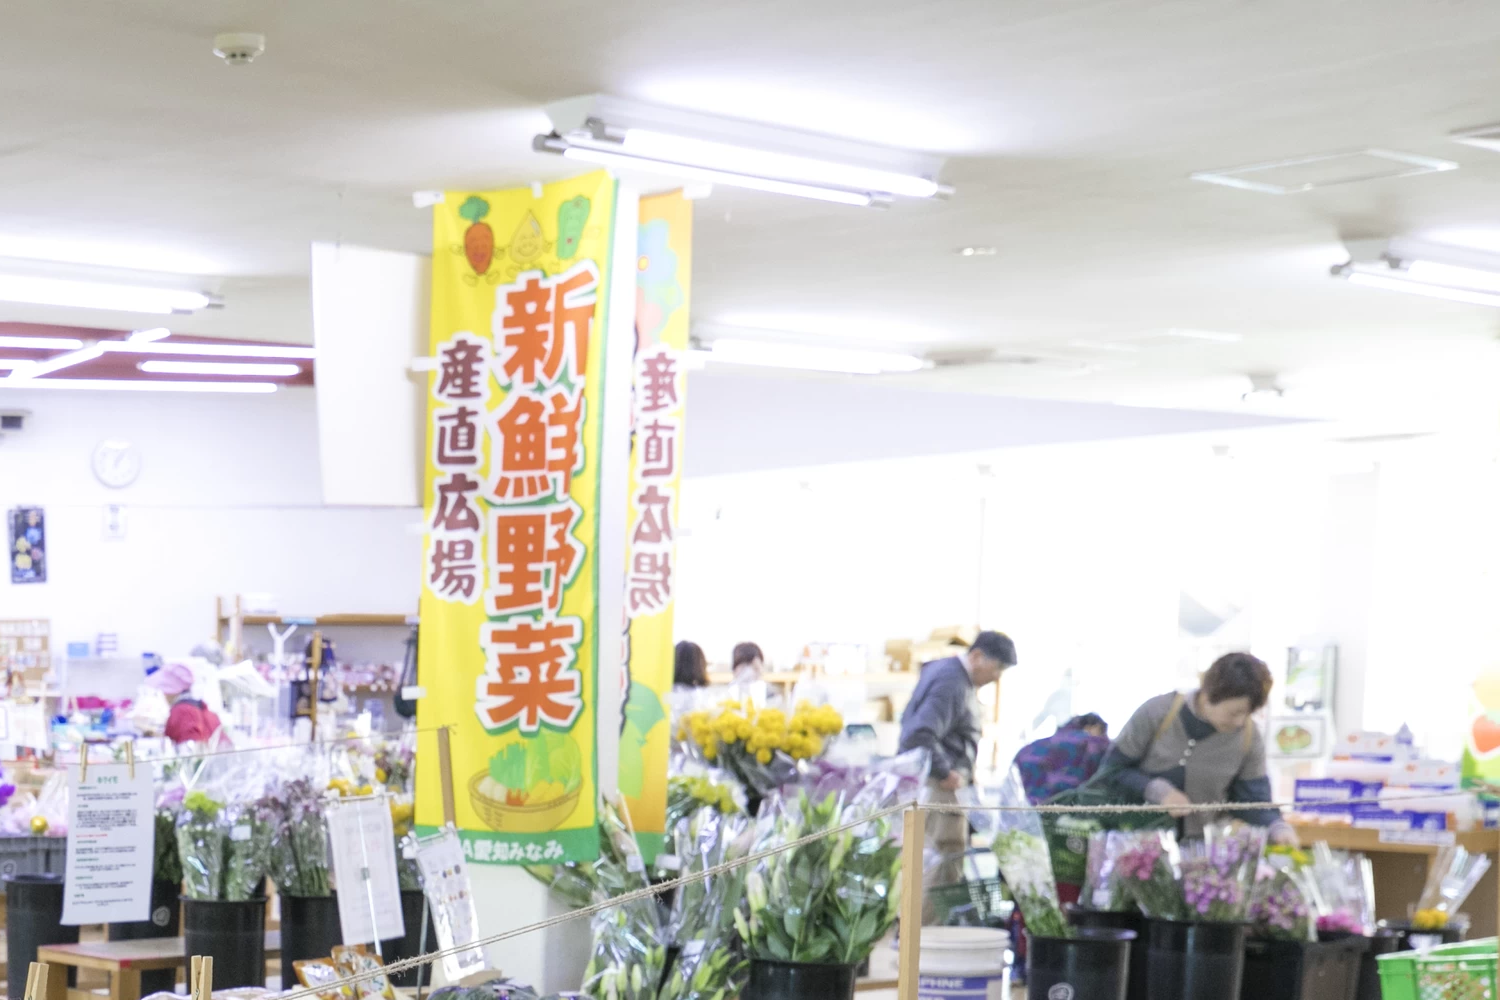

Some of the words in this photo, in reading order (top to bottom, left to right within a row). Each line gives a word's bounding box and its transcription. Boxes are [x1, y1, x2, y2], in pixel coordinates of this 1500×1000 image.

[429, 337, 485, 600] 産直広場
[486, 268, 595, 728] 新鮮野菜
[462, 838, 565, 863] A愛知みなみ
